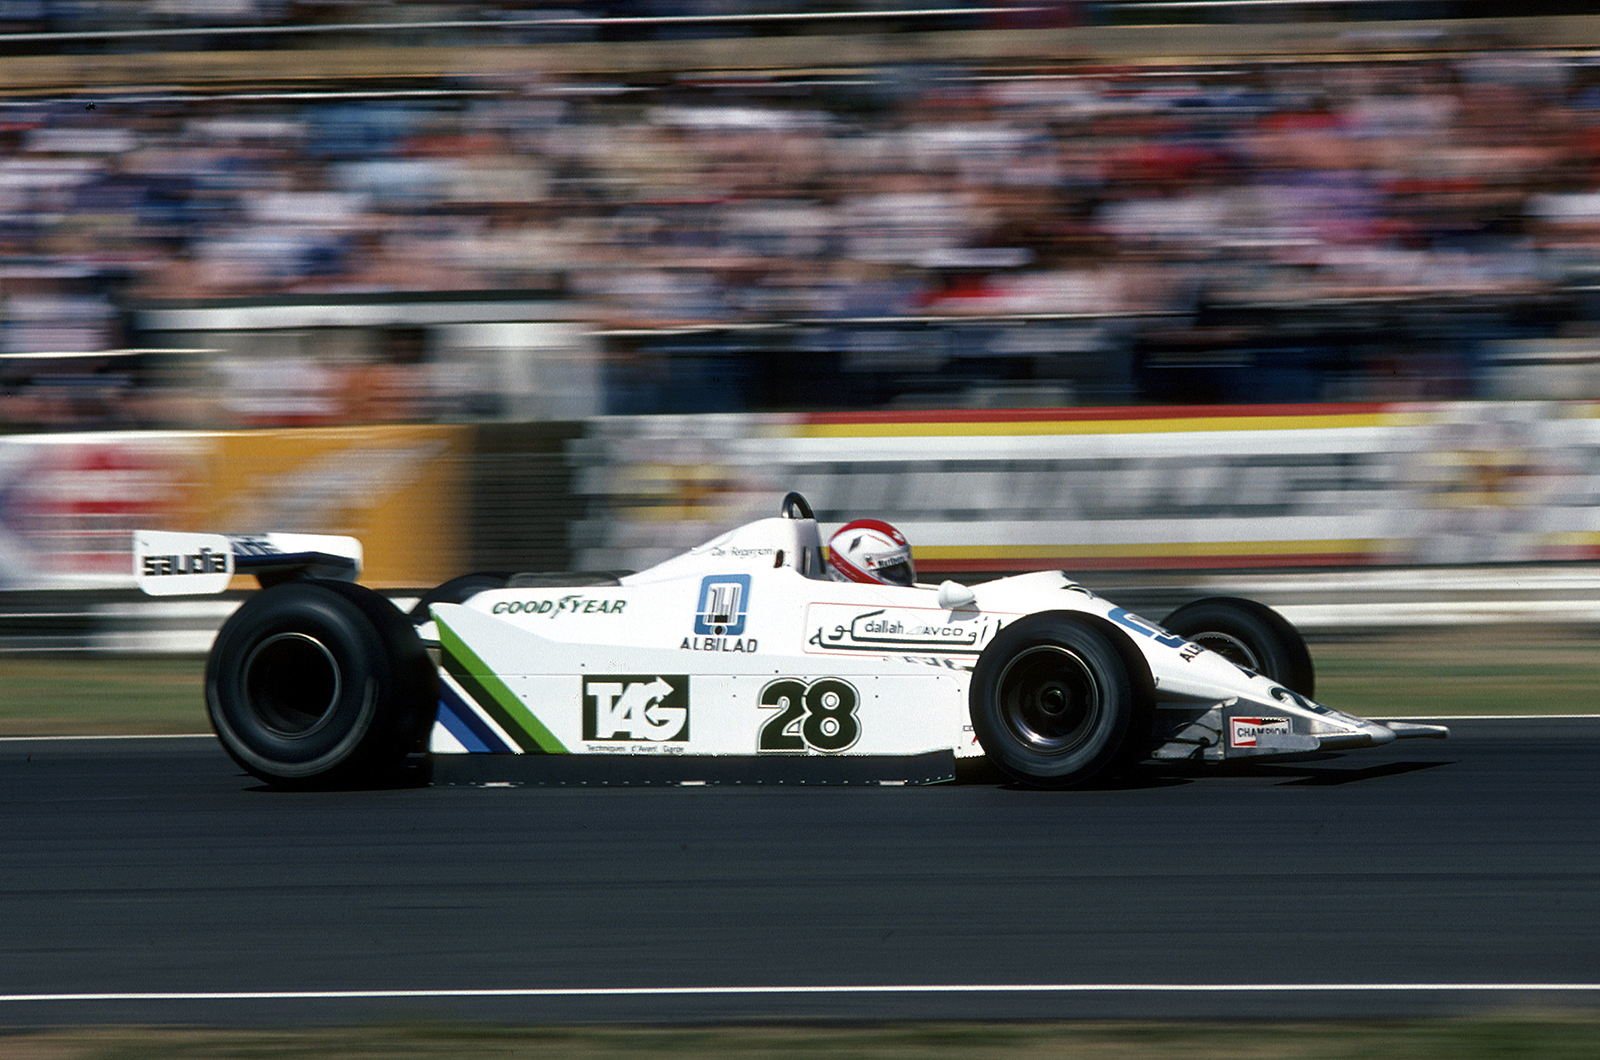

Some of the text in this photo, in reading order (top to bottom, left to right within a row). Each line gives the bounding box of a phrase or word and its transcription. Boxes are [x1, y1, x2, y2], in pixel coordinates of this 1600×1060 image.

[143, 548, 227, 576] saudia
[492, 596, 627, 616] GOODYEAR
[864, 620, 964, 637] dallah AVCO
[680, 636, 758, 653] ALBILAD
[586, 675, 687, 741] TAG
[757, 676, 861, 754] 28
